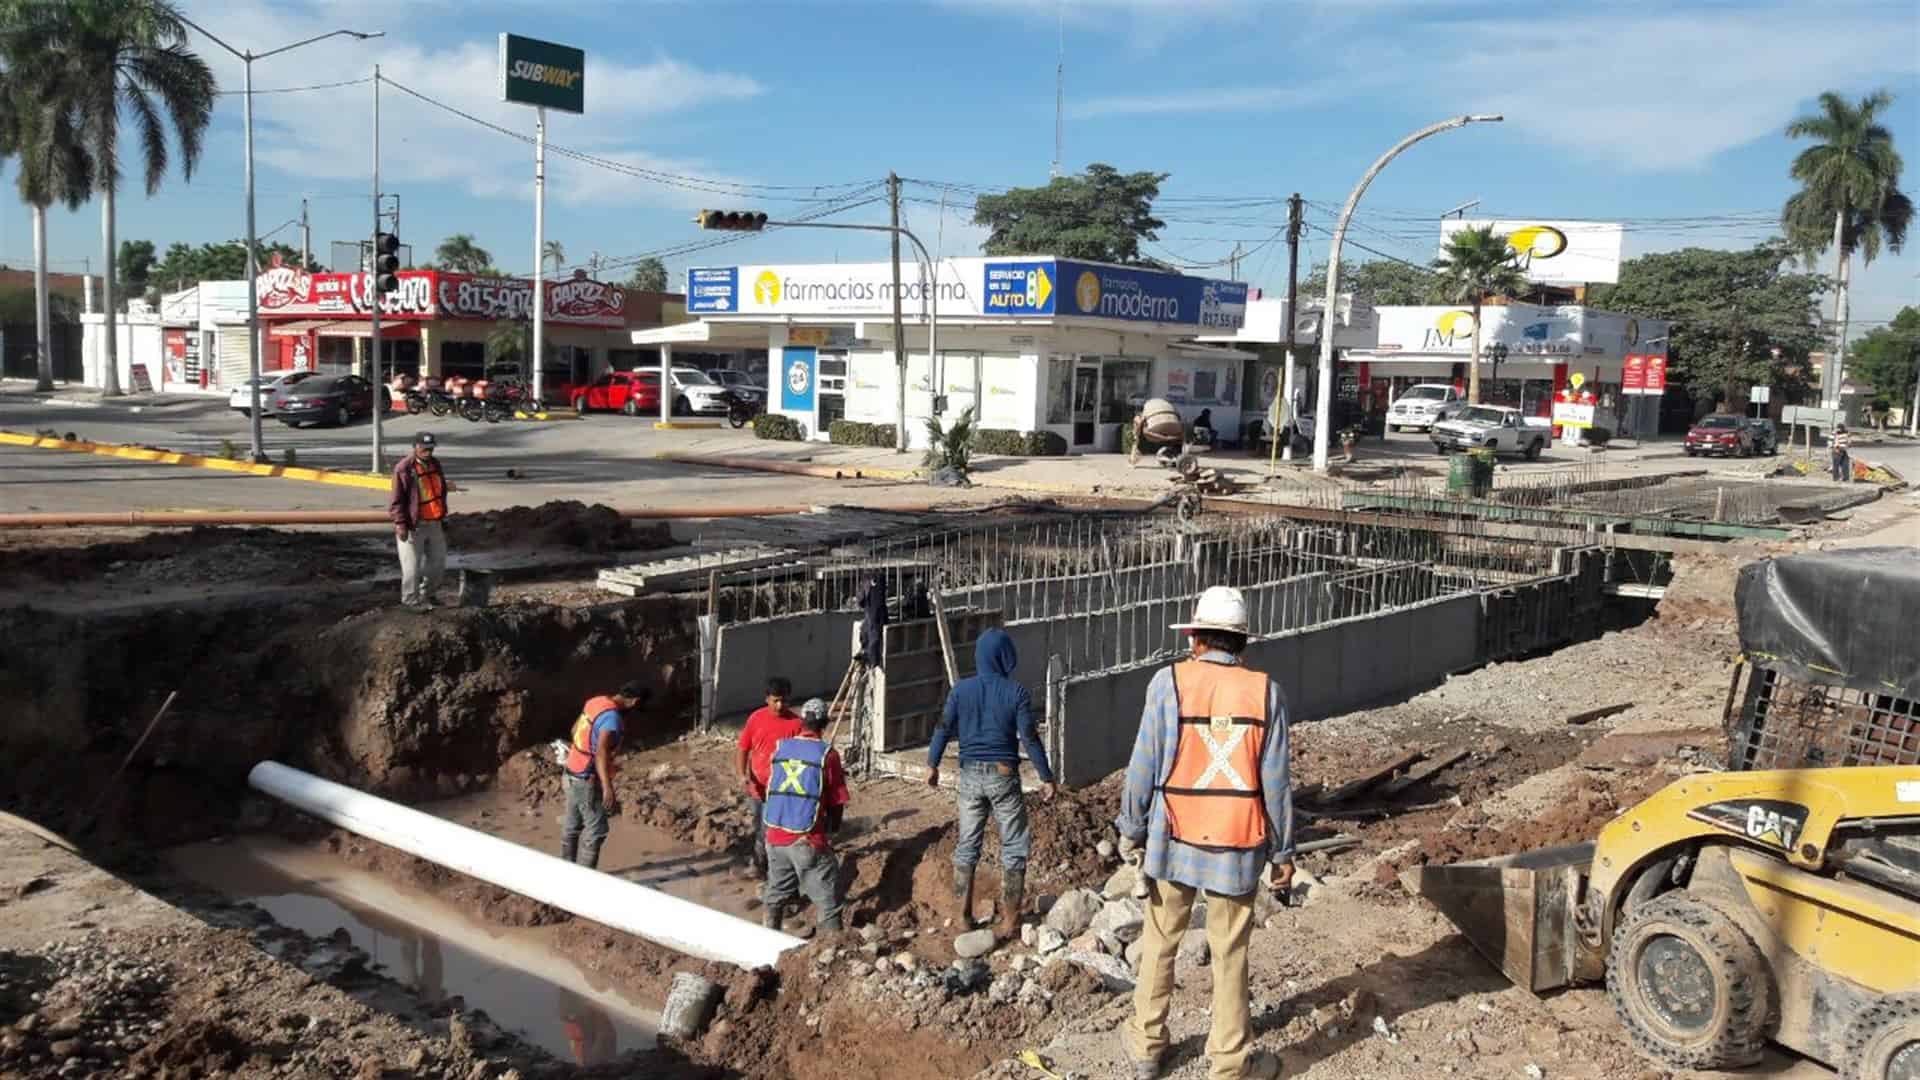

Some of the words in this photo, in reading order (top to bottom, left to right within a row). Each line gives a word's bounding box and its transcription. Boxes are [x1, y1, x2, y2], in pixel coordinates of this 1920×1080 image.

[510, 59, 581, 91] SUBWAY
[459, 281, 534, 319] 815-907
[784, 276, 874, 301] farmacias
[879, 278, 966, 301] moderna
[990, 293, 1024, 307] AUTO
[1102, 287, 1178, 320] moderna
[1746, 804, 1799, 851] CAT
